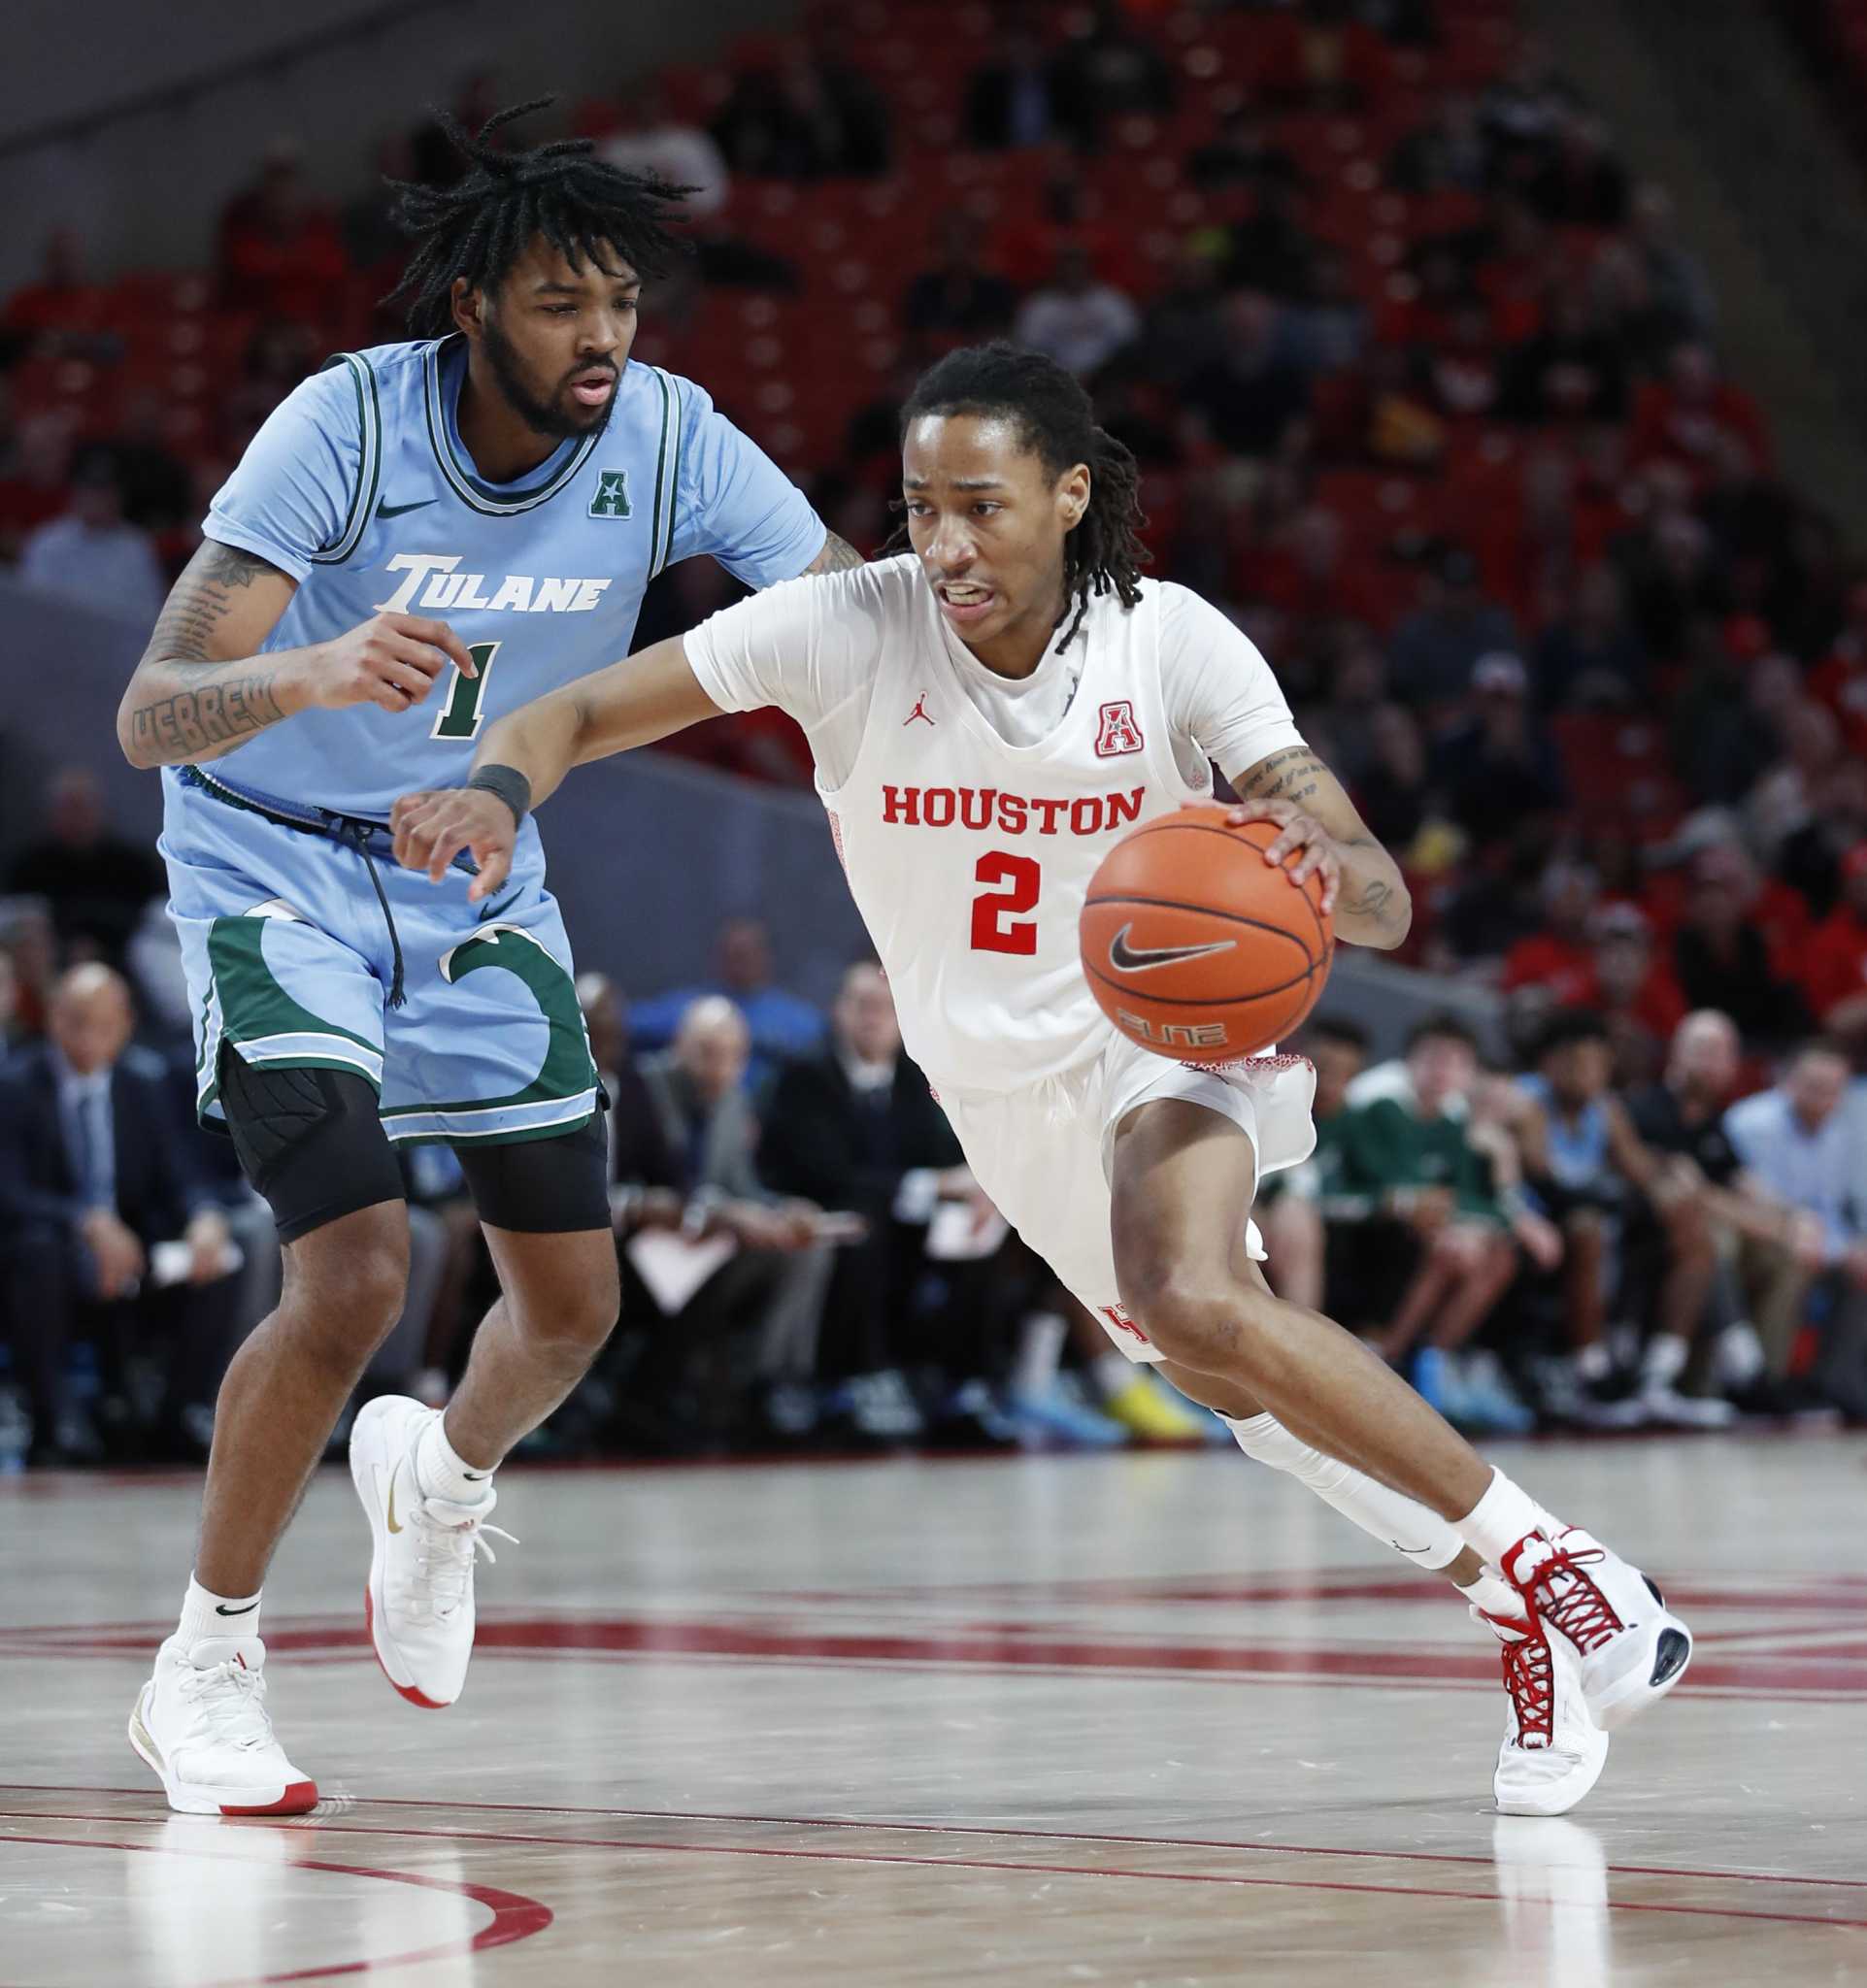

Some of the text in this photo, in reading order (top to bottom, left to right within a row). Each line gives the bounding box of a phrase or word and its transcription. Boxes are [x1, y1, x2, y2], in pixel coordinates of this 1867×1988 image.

[373, 553, 613, 614] TULANE
[429, 641, 502, 741] 1
[882, 785, 1146, 836] HOUSTON
[971, 850, 1041, 956] 2
[1117, 1008, 1228, 1046] ELITE
